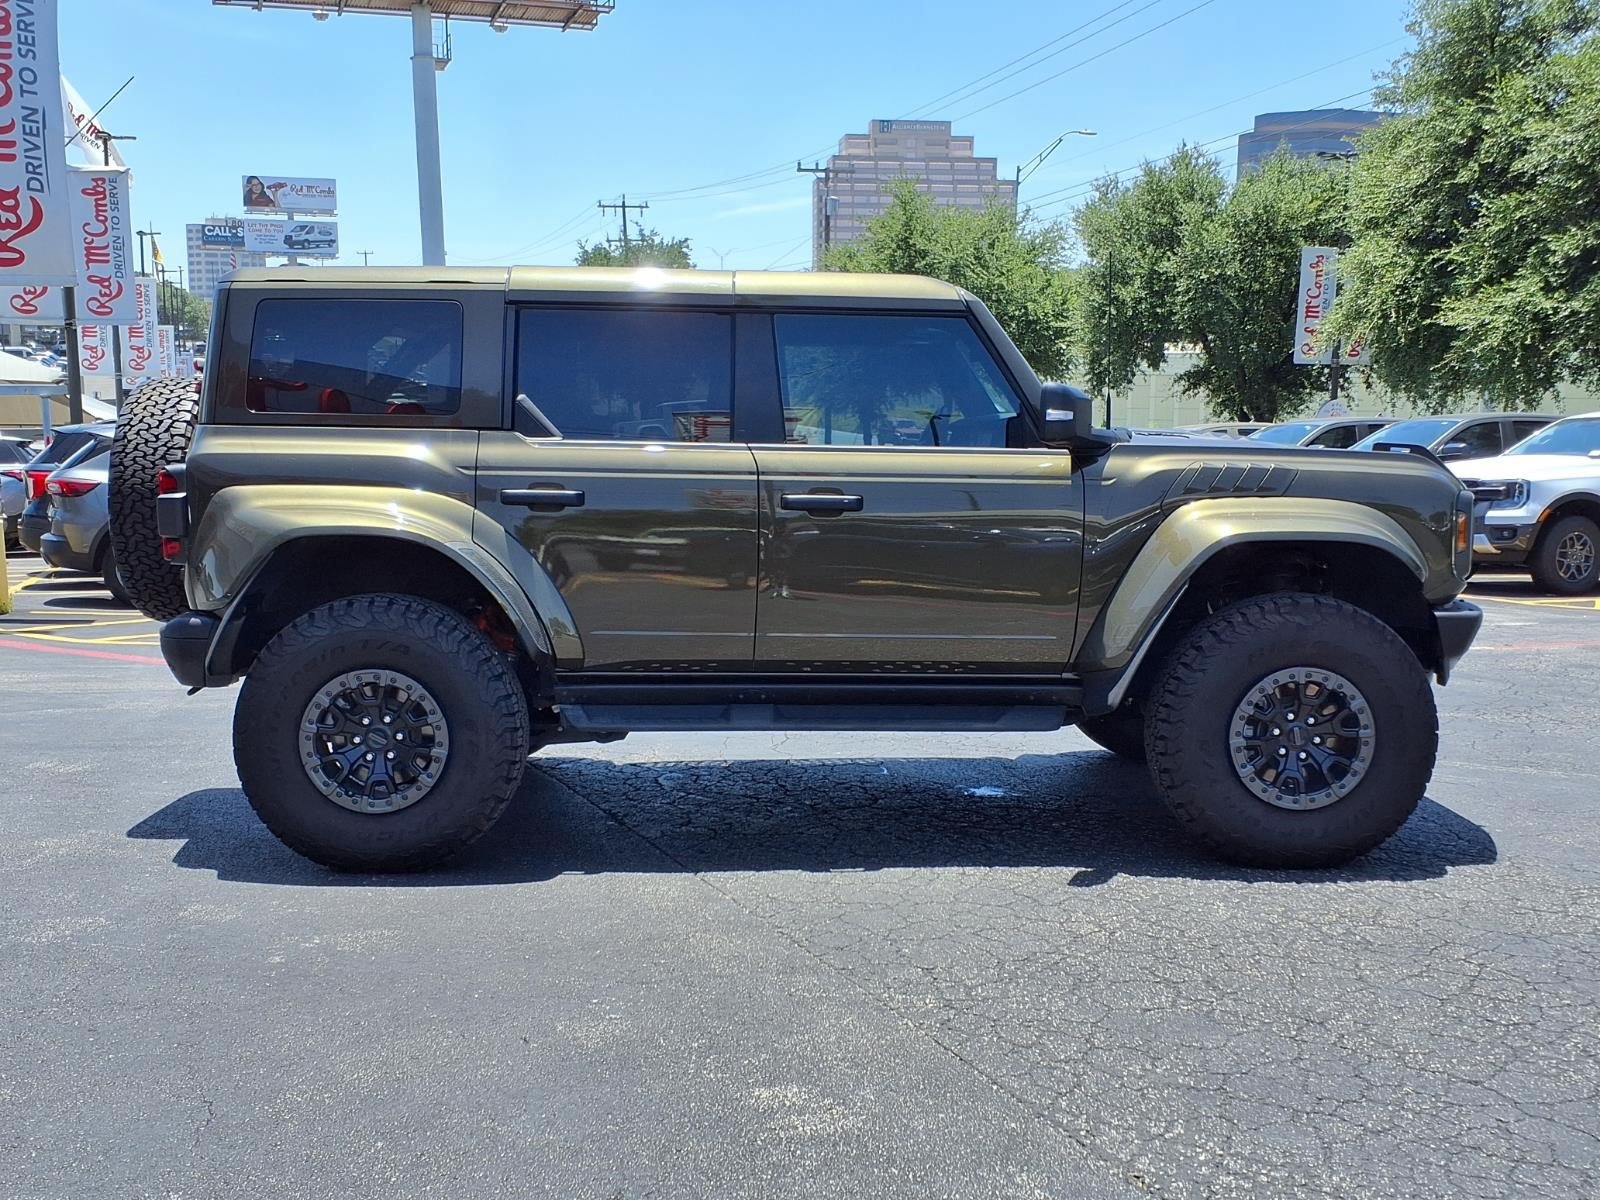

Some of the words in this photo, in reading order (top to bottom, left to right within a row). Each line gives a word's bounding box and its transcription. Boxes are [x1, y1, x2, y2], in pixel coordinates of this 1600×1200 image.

[18, 66, 38, 98] TO
[21, 106, 45, 194] DRIVEN
[108, 177, 120, 213] SERVE
[81, 176, 111, 271] McCombs
[111, 218, 121, 233] TO
[113, 236, 125, 279] DRIVEN
[10, 285, 48, 315] Re
[86, 275, 123, 316] Red
[143, 283, 151, 307] SERVE
[1304, 254, 1325, 323] McCombs
[144, 308, 151, 318] TO
[145, 320, 153, 348] DRIVEN
[81, 344, 105, 371] Red
[128, 345, 152, 371] Red
